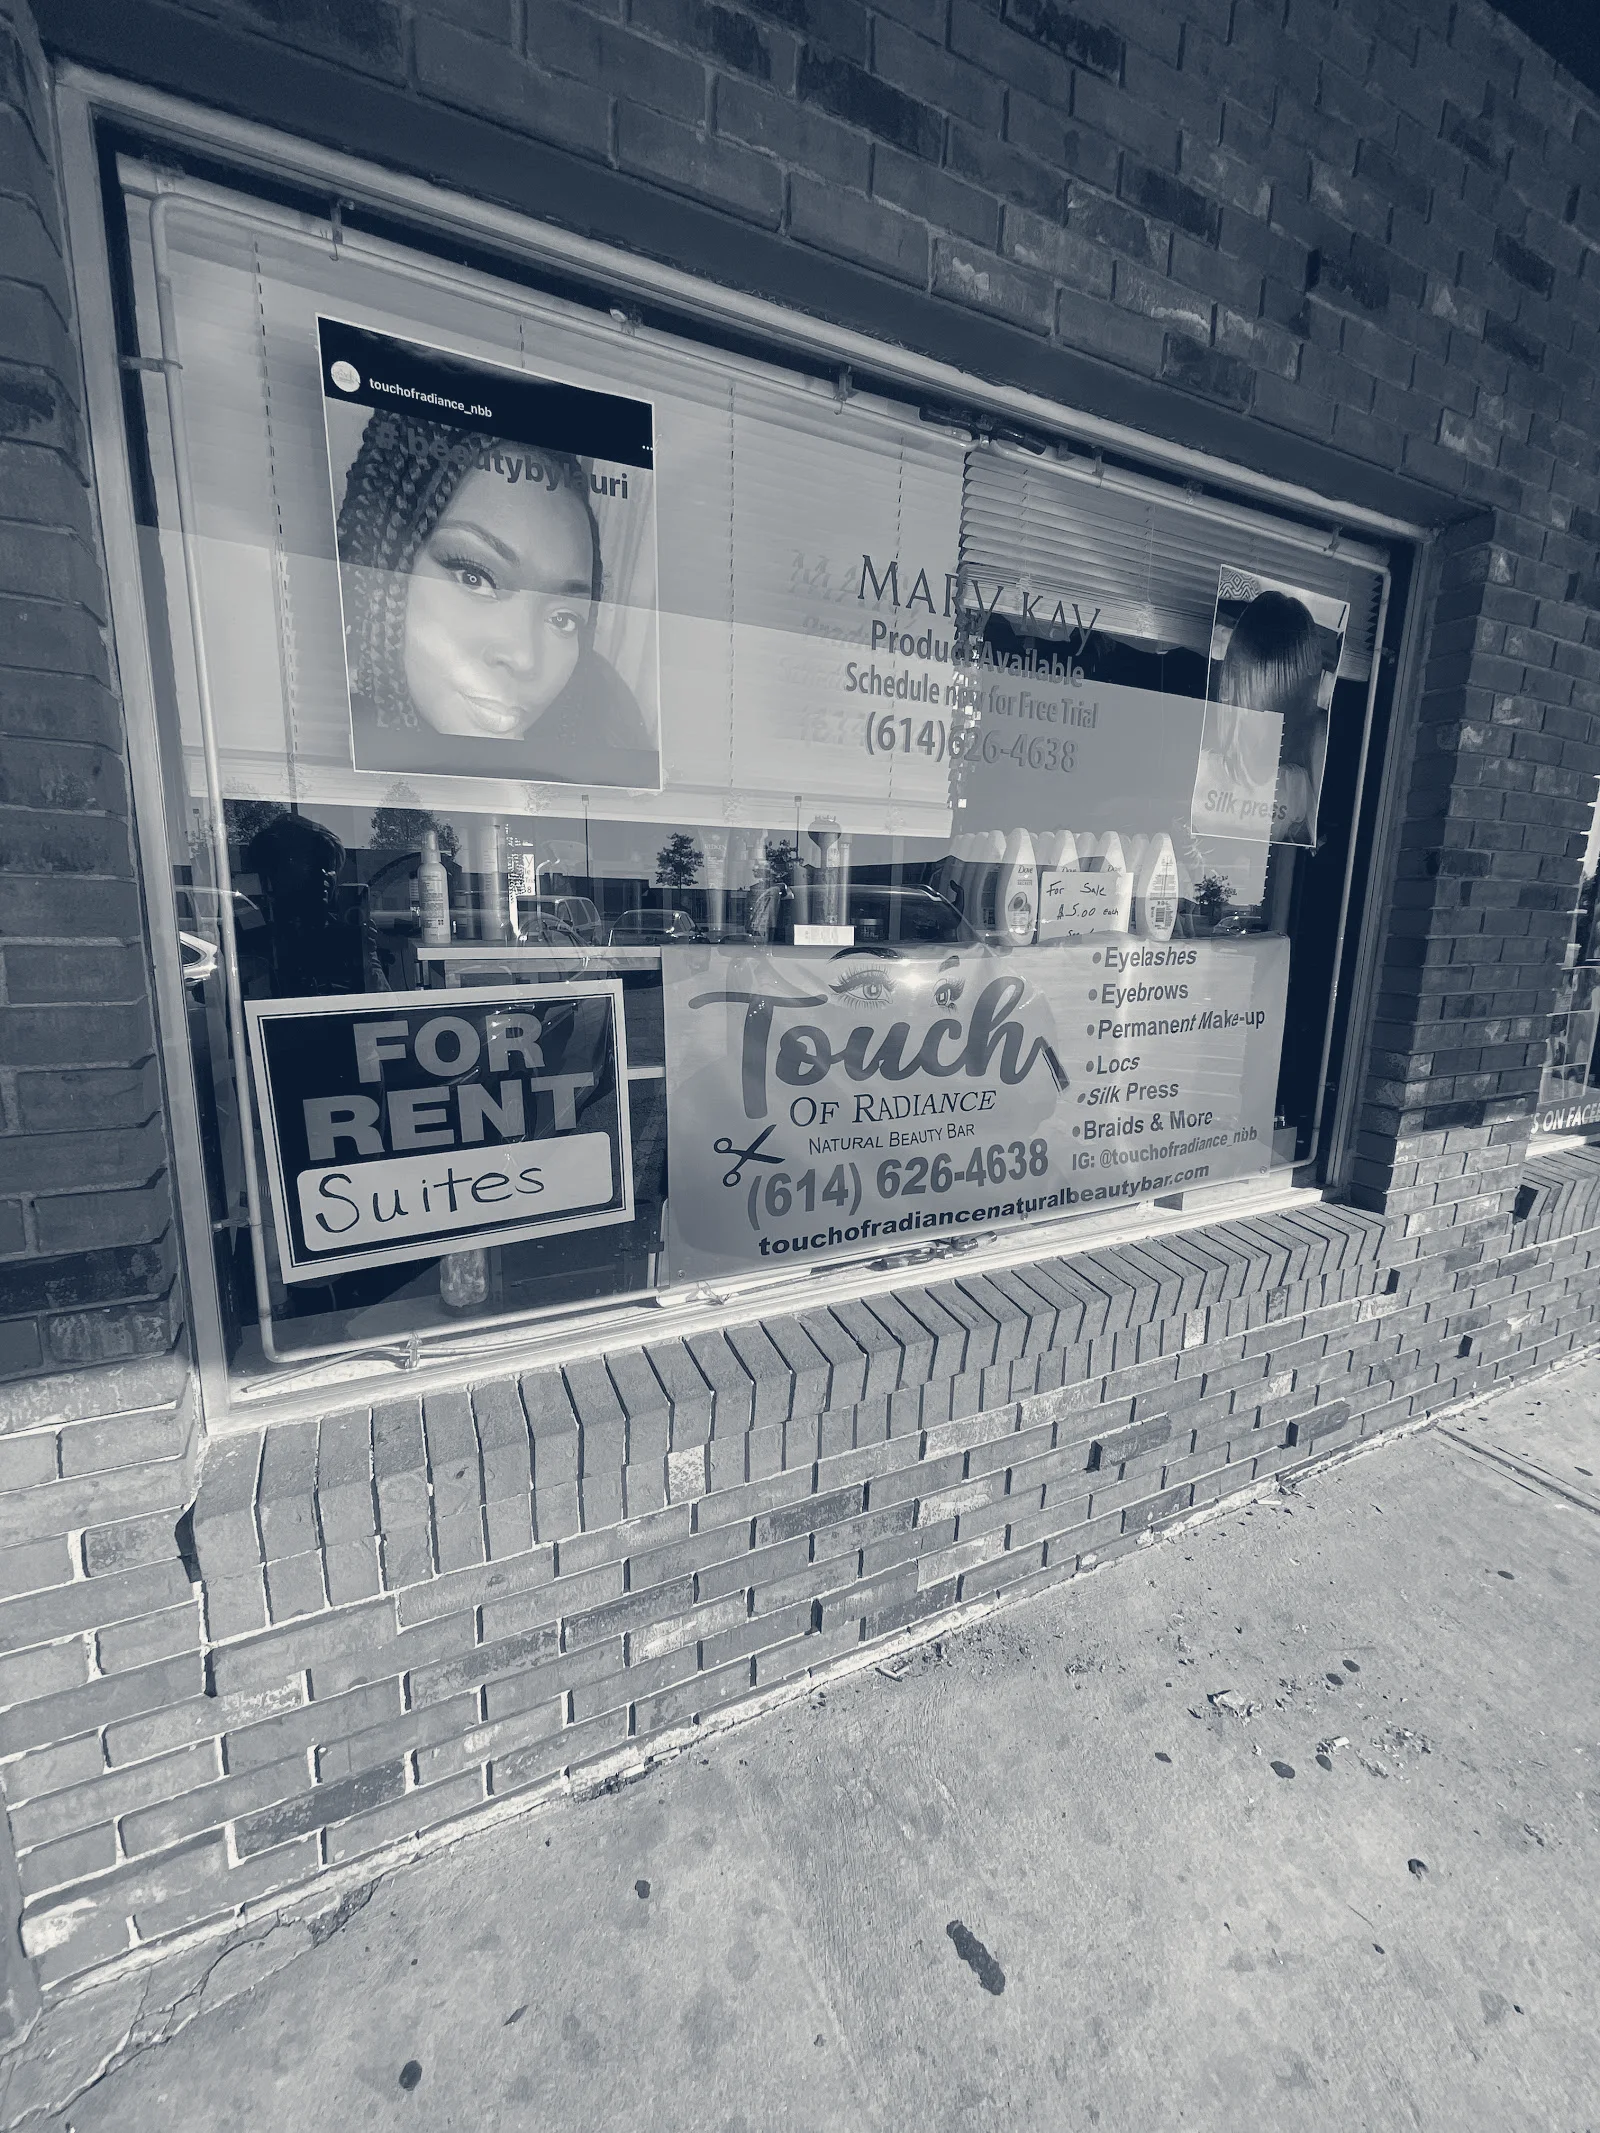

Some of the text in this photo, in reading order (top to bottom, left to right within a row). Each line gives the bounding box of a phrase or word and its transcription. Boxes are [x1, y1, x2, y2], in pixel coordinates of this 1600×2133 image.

[369, 378, 493, 418] touchofradiance_nbb
[1020, 592, 1101, 656] KAY
[978, 640, 1085, 687] Available
[845, 661, 940, 704] Schedule
[989, 684, 1016, 716] for
[1019, 690, 1057, 722] Free
[1061, 697, 1098, 729] Trial
[866, 711, 1078, 773] (614)626-4638
[1205, 789, 1288, 820] Silk press
[1018, 865, 1034, 874] Dove
[1046, 880, 1107, 896] For Sale
[1104, 946, 1197, 973] Eyelashes
[1101, 982, 1189, 1008] Eyebrows
[1098, 1007, 1266, 1040] Permanent Make-up
[353, 1013, 545, 1083] FOR
[688, 975, 1043, 1119] Touch
[1097, 1054, 1141, 1076] Locs
[790, 1090, 997, 1127] OF RADIANCE
[1087, 1081, 1179, 1106] Silk Press
[303, 1072, 594, 1160] RENT
[1083, 1108, 1213, 1141] Braids & More
[1543, 1108, 1566, 1131] ON
[809, 1122, 975, 1156] NATURAL BEAUTY BAR
[1072, 1152, 1096, 1171] IG:
[316, 1168, 545, 1233] Suites
[746, 1138, 1049, 1231] (614) 626-4638
[758, 1162, 1210, 1256] touchofradiancenaturalbeautybar.com
